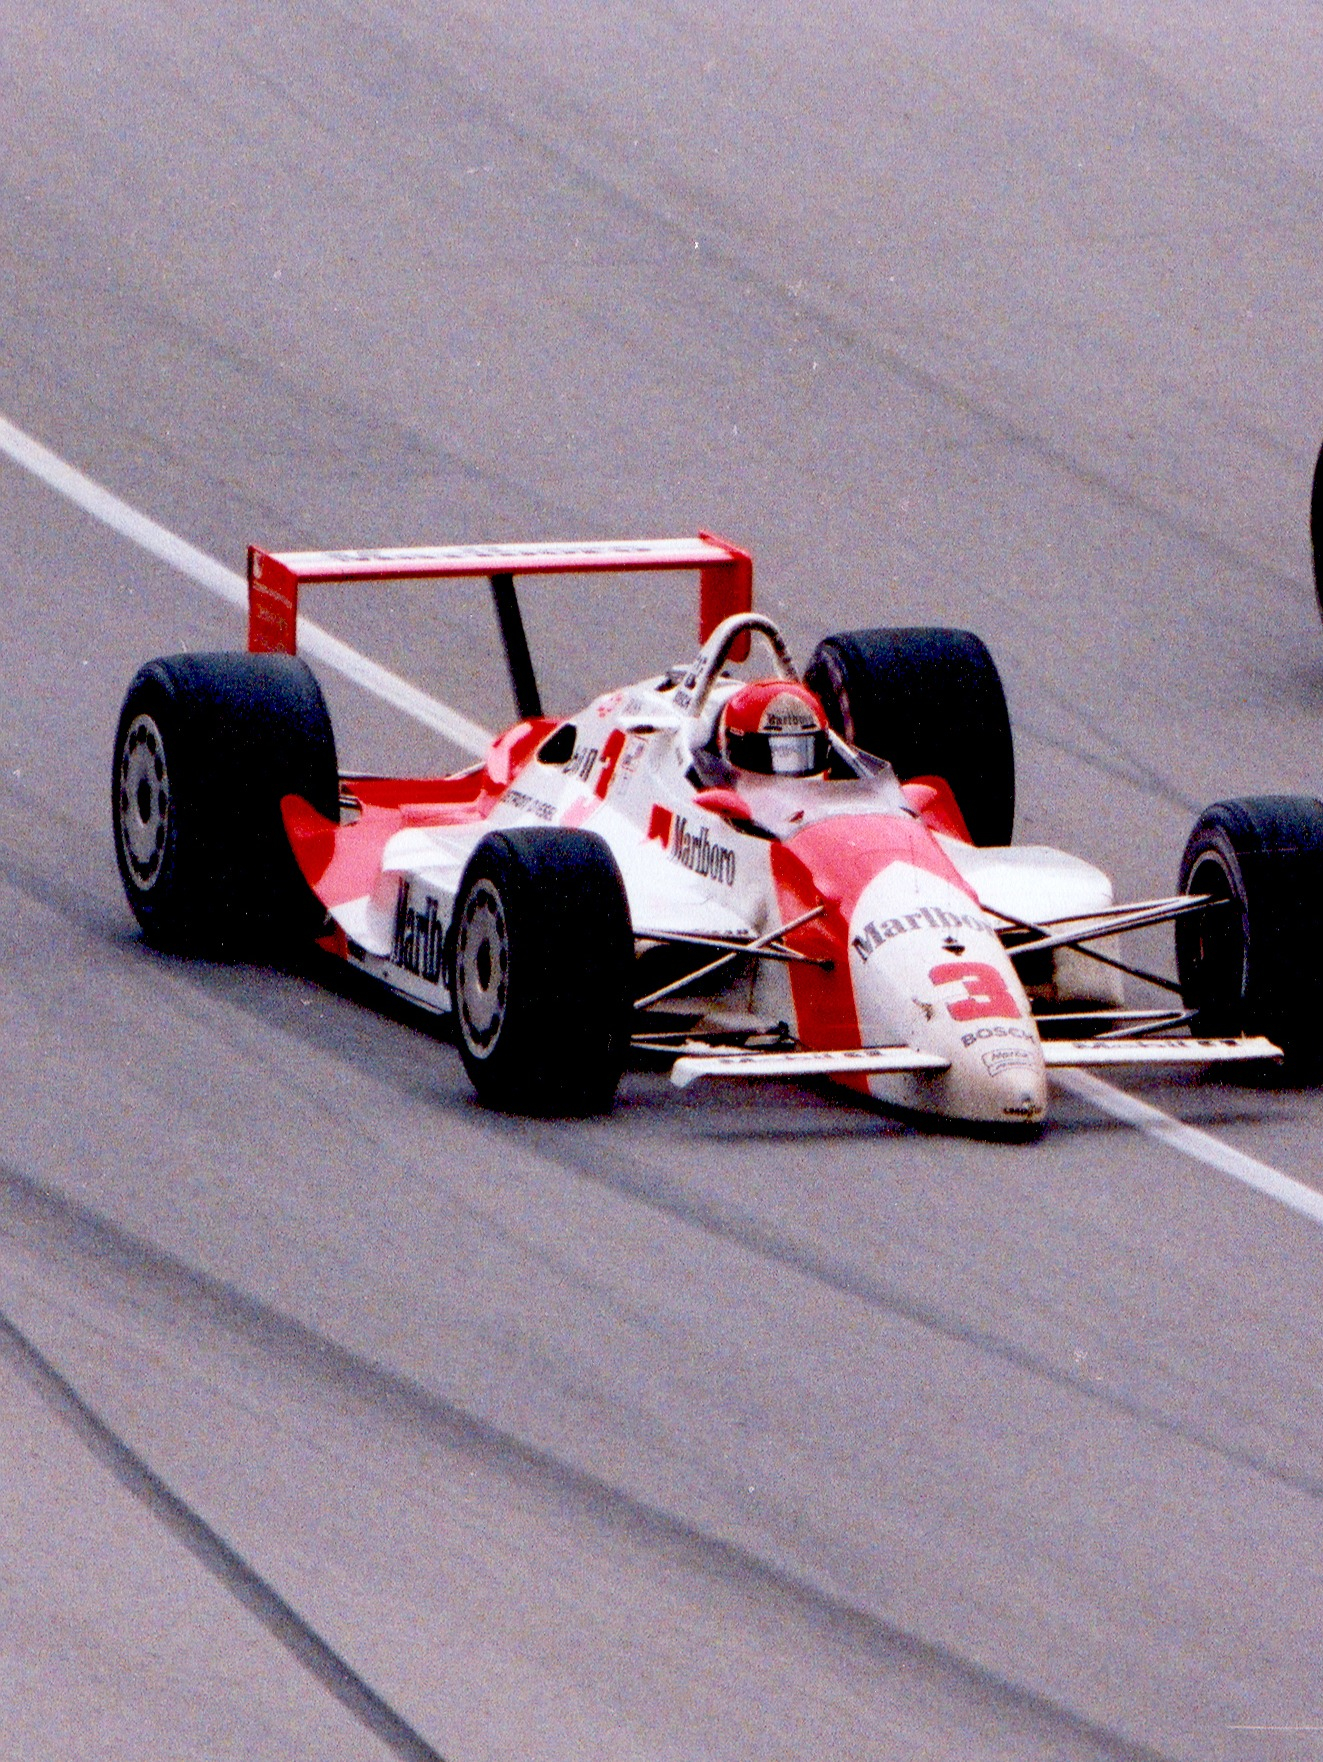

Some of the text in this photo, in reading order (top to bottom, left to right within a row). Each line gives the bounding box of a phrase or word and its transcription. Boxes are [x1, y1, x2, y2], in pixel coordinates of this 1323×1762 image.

[672, 814, 736, 887] Marlboro
[851, 906, 995, 964] Marlbo
[928, 961, 1022, 1022] 3
